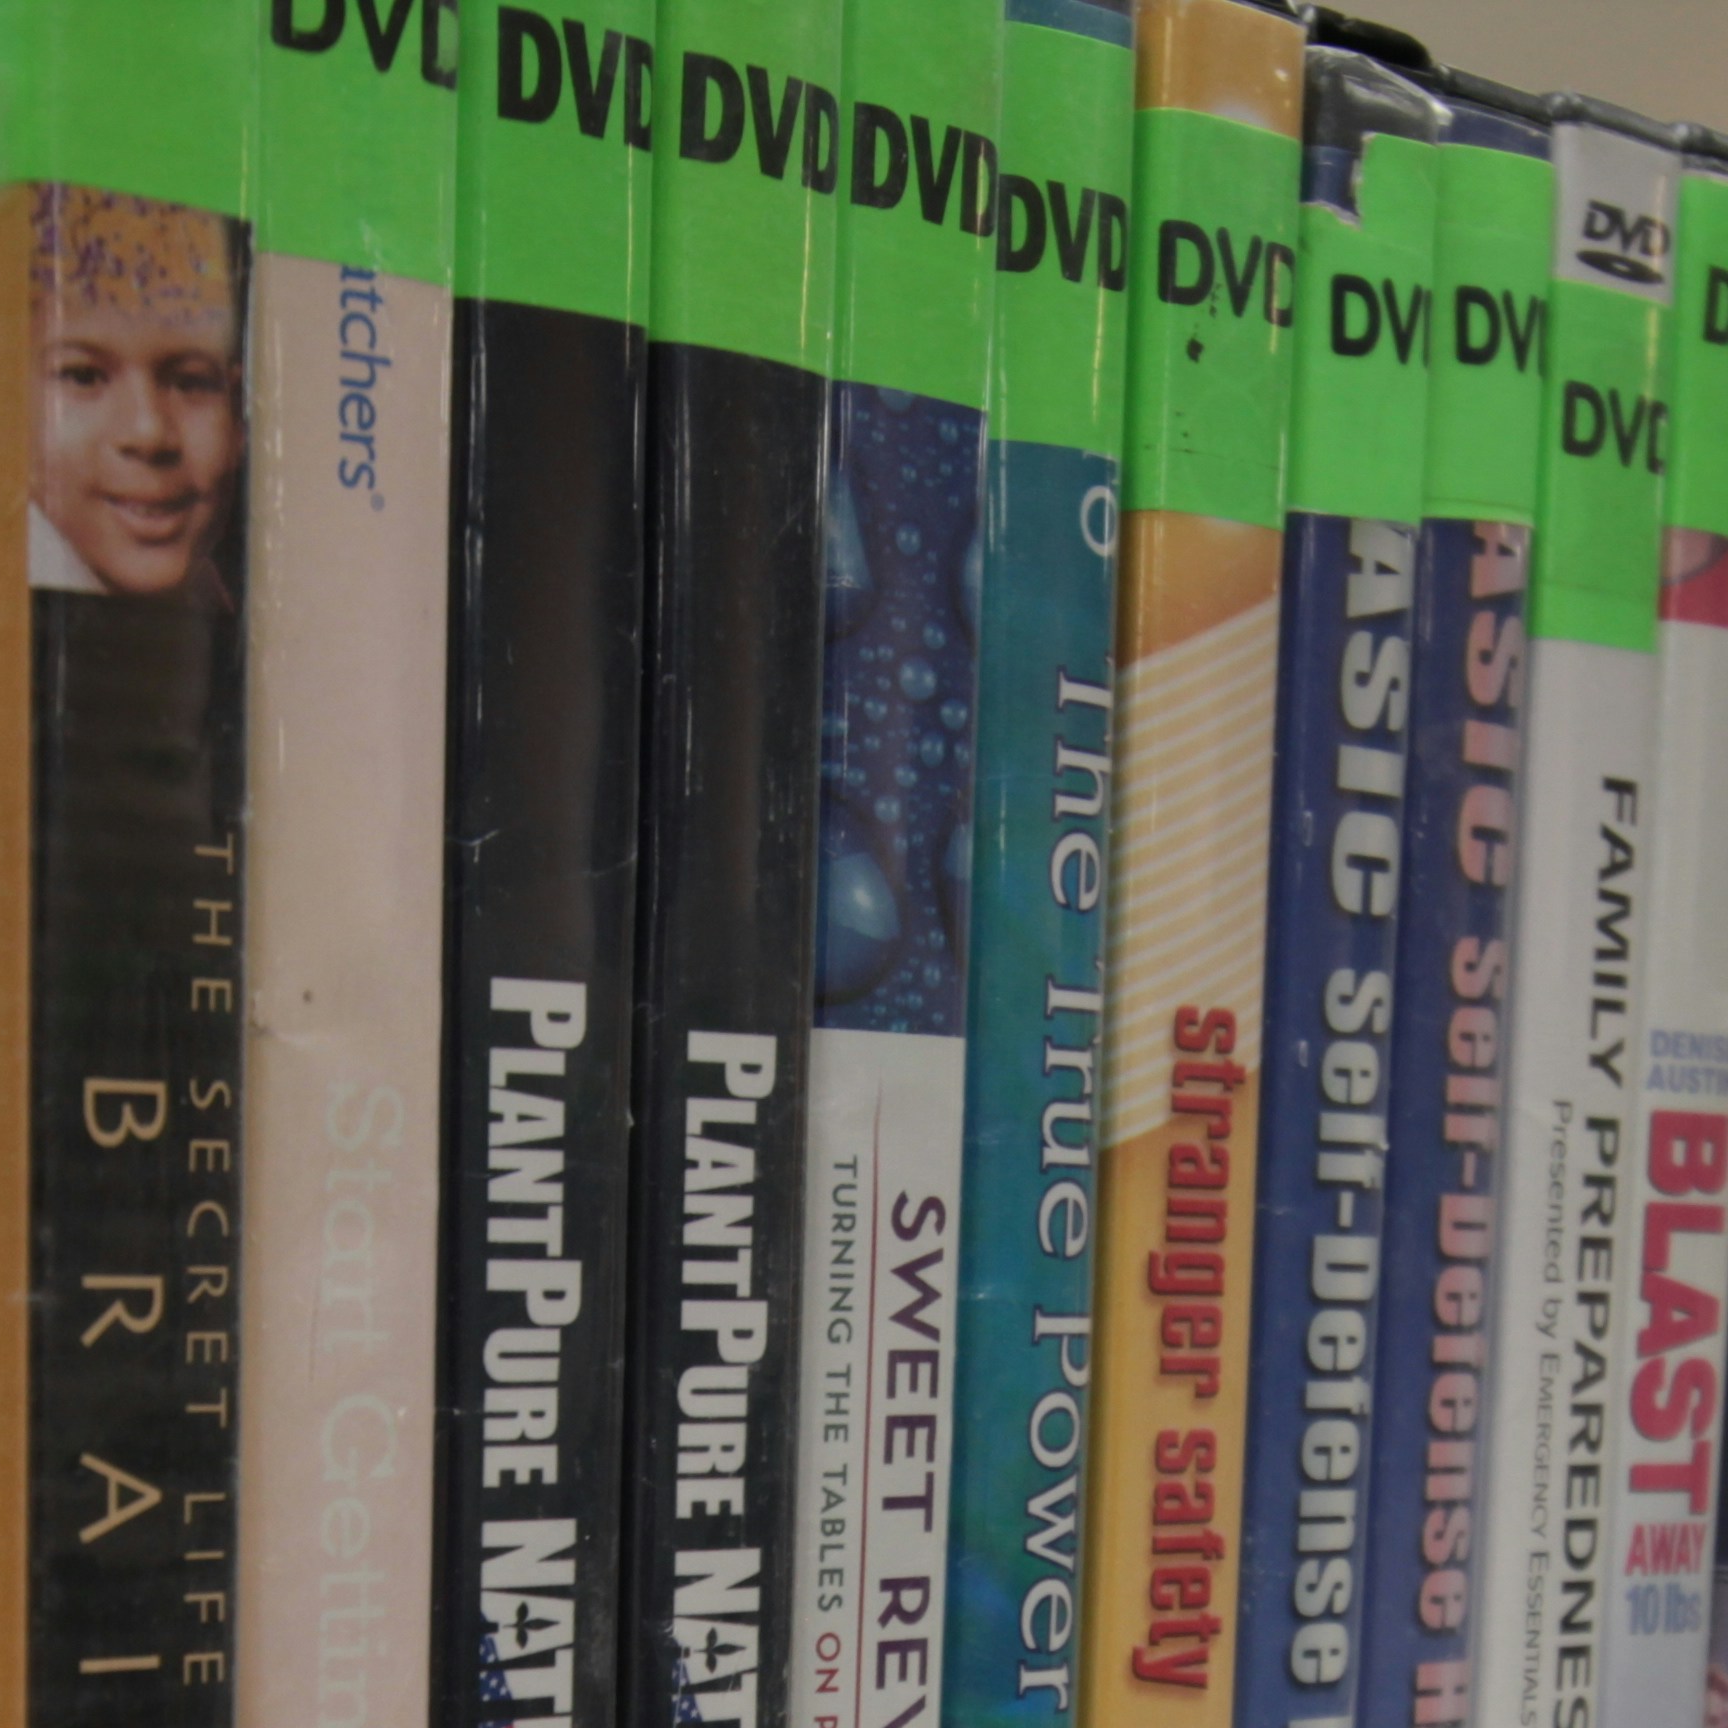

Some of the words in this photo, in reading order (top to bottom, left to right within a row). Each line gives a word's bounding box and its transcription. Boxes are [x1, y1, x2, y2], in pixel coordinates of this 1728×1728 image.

[497, 6, 653, 153] DVD
[679, 51, 838, 194] DVD
[850, 101, 998, 238] DVD
[996, 173, 1128, 292] DVD
[1583, 200, 1669, 258] DVD
[1158, 219, 1295, 328] DVD
[190, 831, 235, 1014] THE
[1588, 776, 1639, 1088] FAMILY
[185, 1077, 231, 1429] SECRET
[318, 1081, 406, 1355] Start
[827, 1155, 858, 1346] TURNING
[1148, 1004, 1246, 1399] stranger
[1541, 1099, 1573, 1283] Presented
[880, 1190, 946, 1533] SWEET
[1535, 1291, 1567, 1341] by
[824, 1364, 851, 1443] THE
[183, 1492, 226, 1686] LIFE
[817, 1464, 847, 1613] TABLES
[1019, 1305, 1092, 1713] Power
[1133, 1427, 1225, 1688] safety
[1625, 1523, 1706, 1575] AWAY
[816, 1632, 841, 1694] ON
